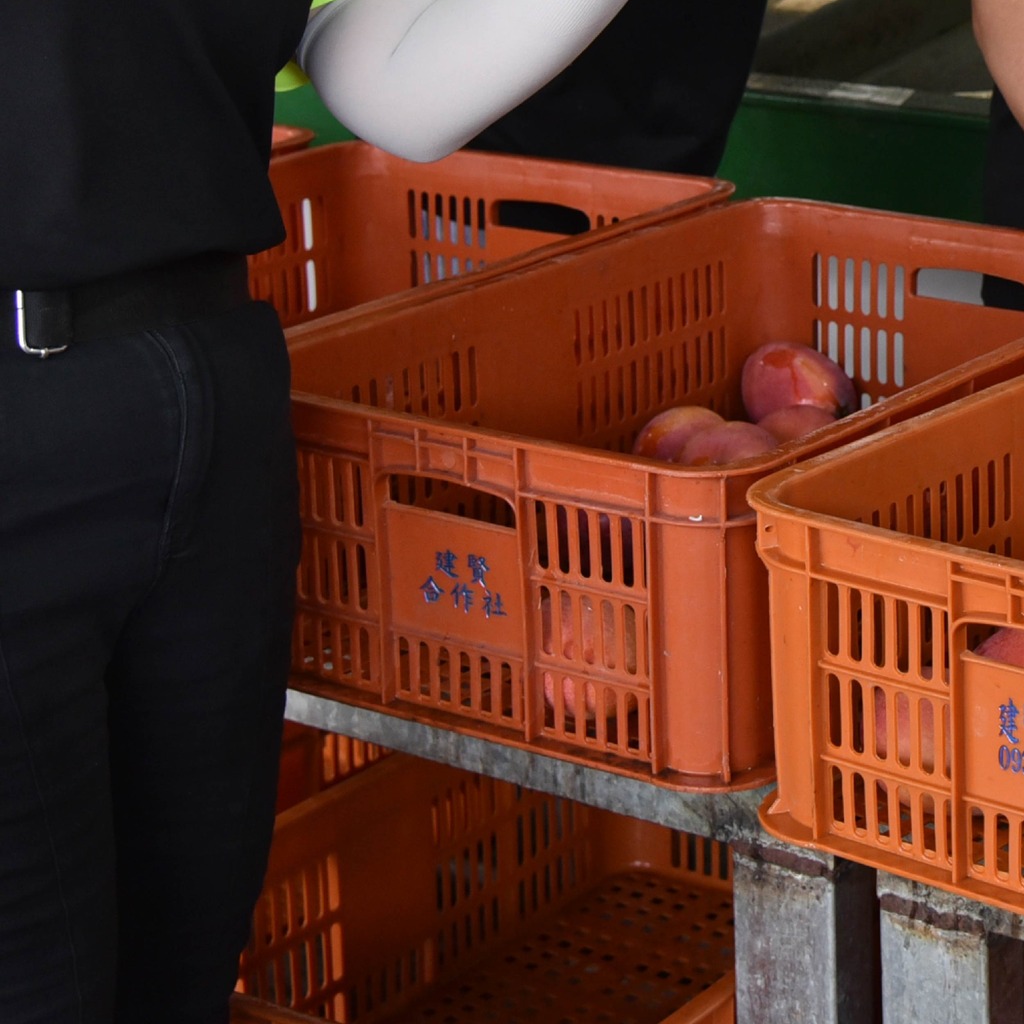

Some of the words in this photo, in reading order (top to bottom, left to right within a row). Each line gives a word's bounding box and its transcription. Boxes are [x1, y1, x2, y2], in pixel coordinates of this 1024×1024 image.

[435, 549, 490, 588] 建賢
[419, 575, 508, 619] 合作社
